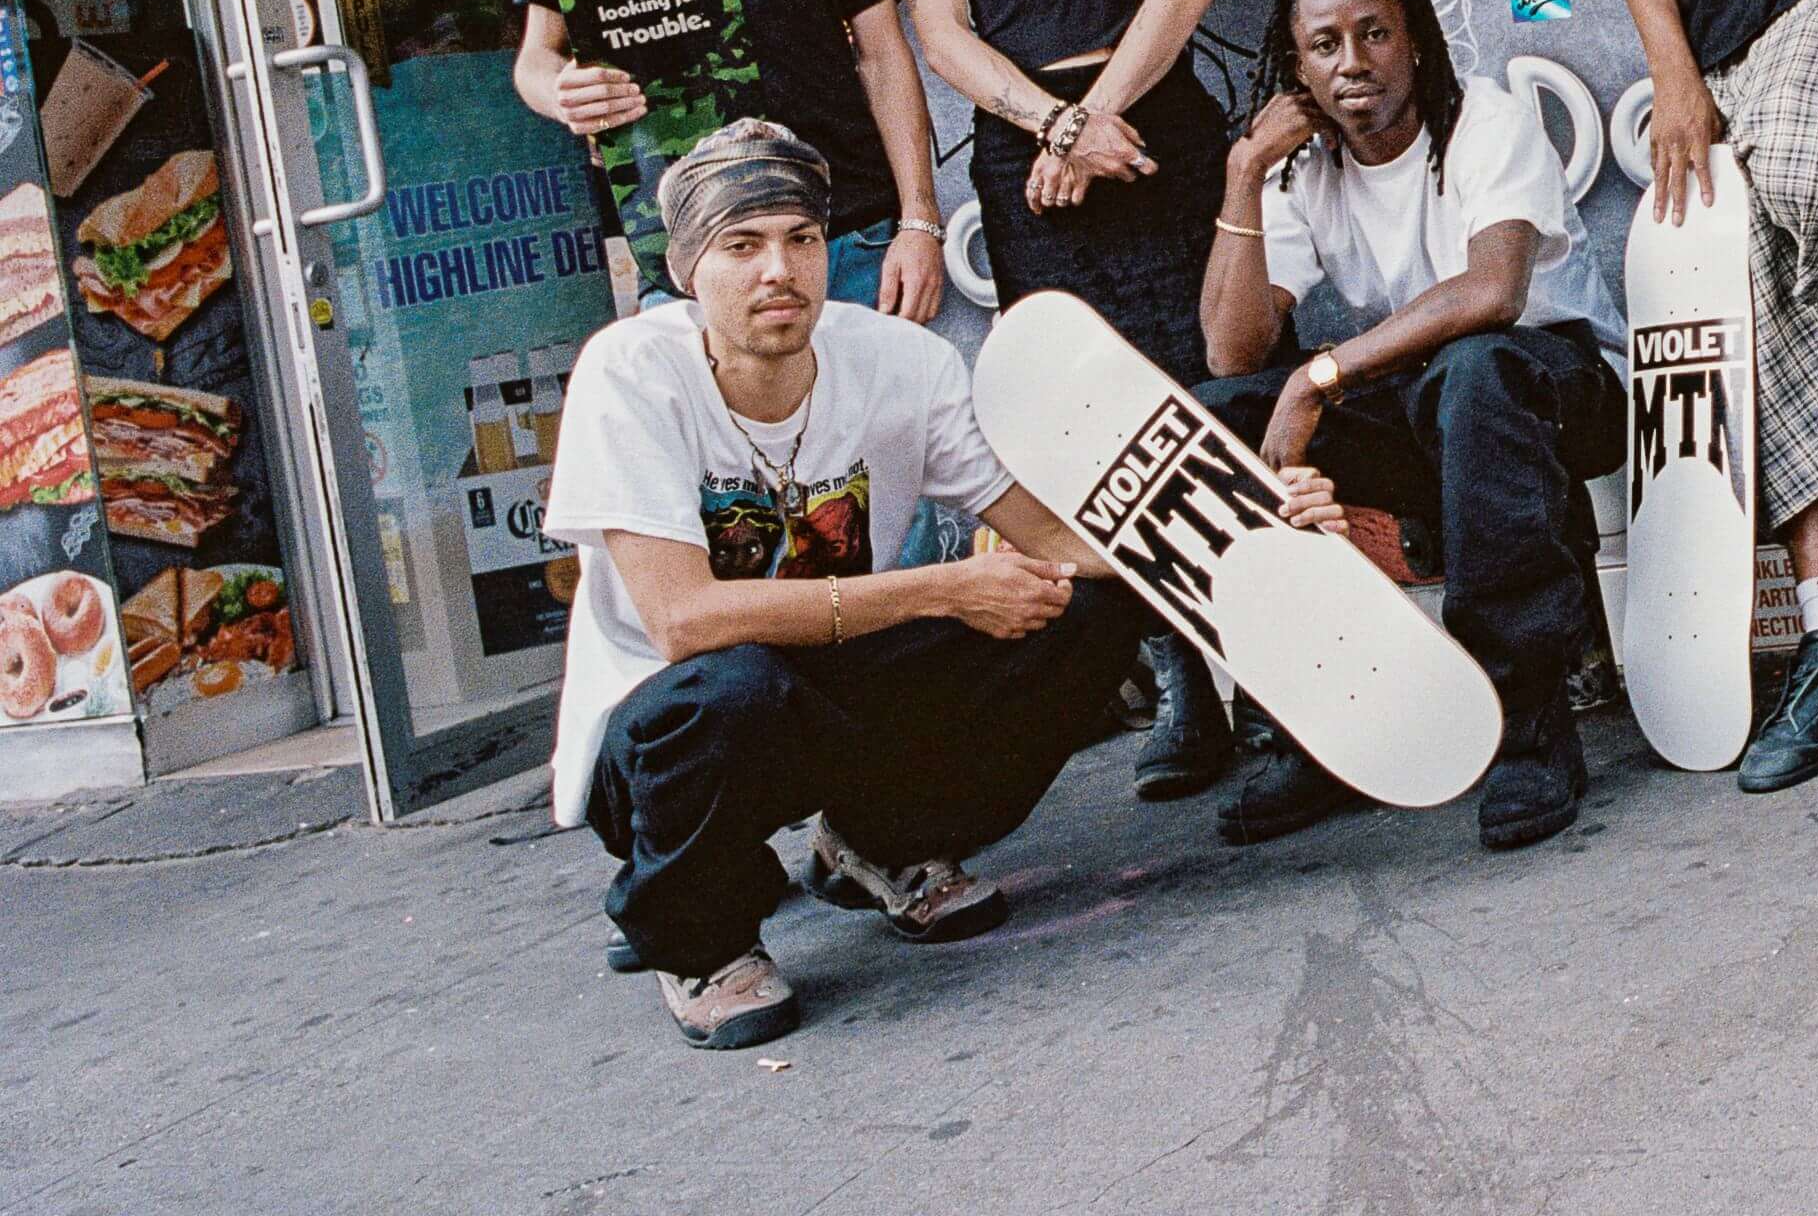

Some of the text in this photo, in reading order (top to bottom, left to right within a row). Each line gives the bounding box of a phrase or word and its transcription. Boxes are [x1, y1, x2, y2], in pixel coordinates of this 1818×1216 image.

[602, 12, 711, 49] Trouble.
[387, 168, 571, 238] WELCOME
[375, 235, 545, 309] HIGHLINE
[1637, 323, 1742, 364] VIOLET
[1081, 403, 1191, 534] VIOLET
[1631, 368, 1746, 524] MTN
[1112, 429, 1315, 662] MTN
